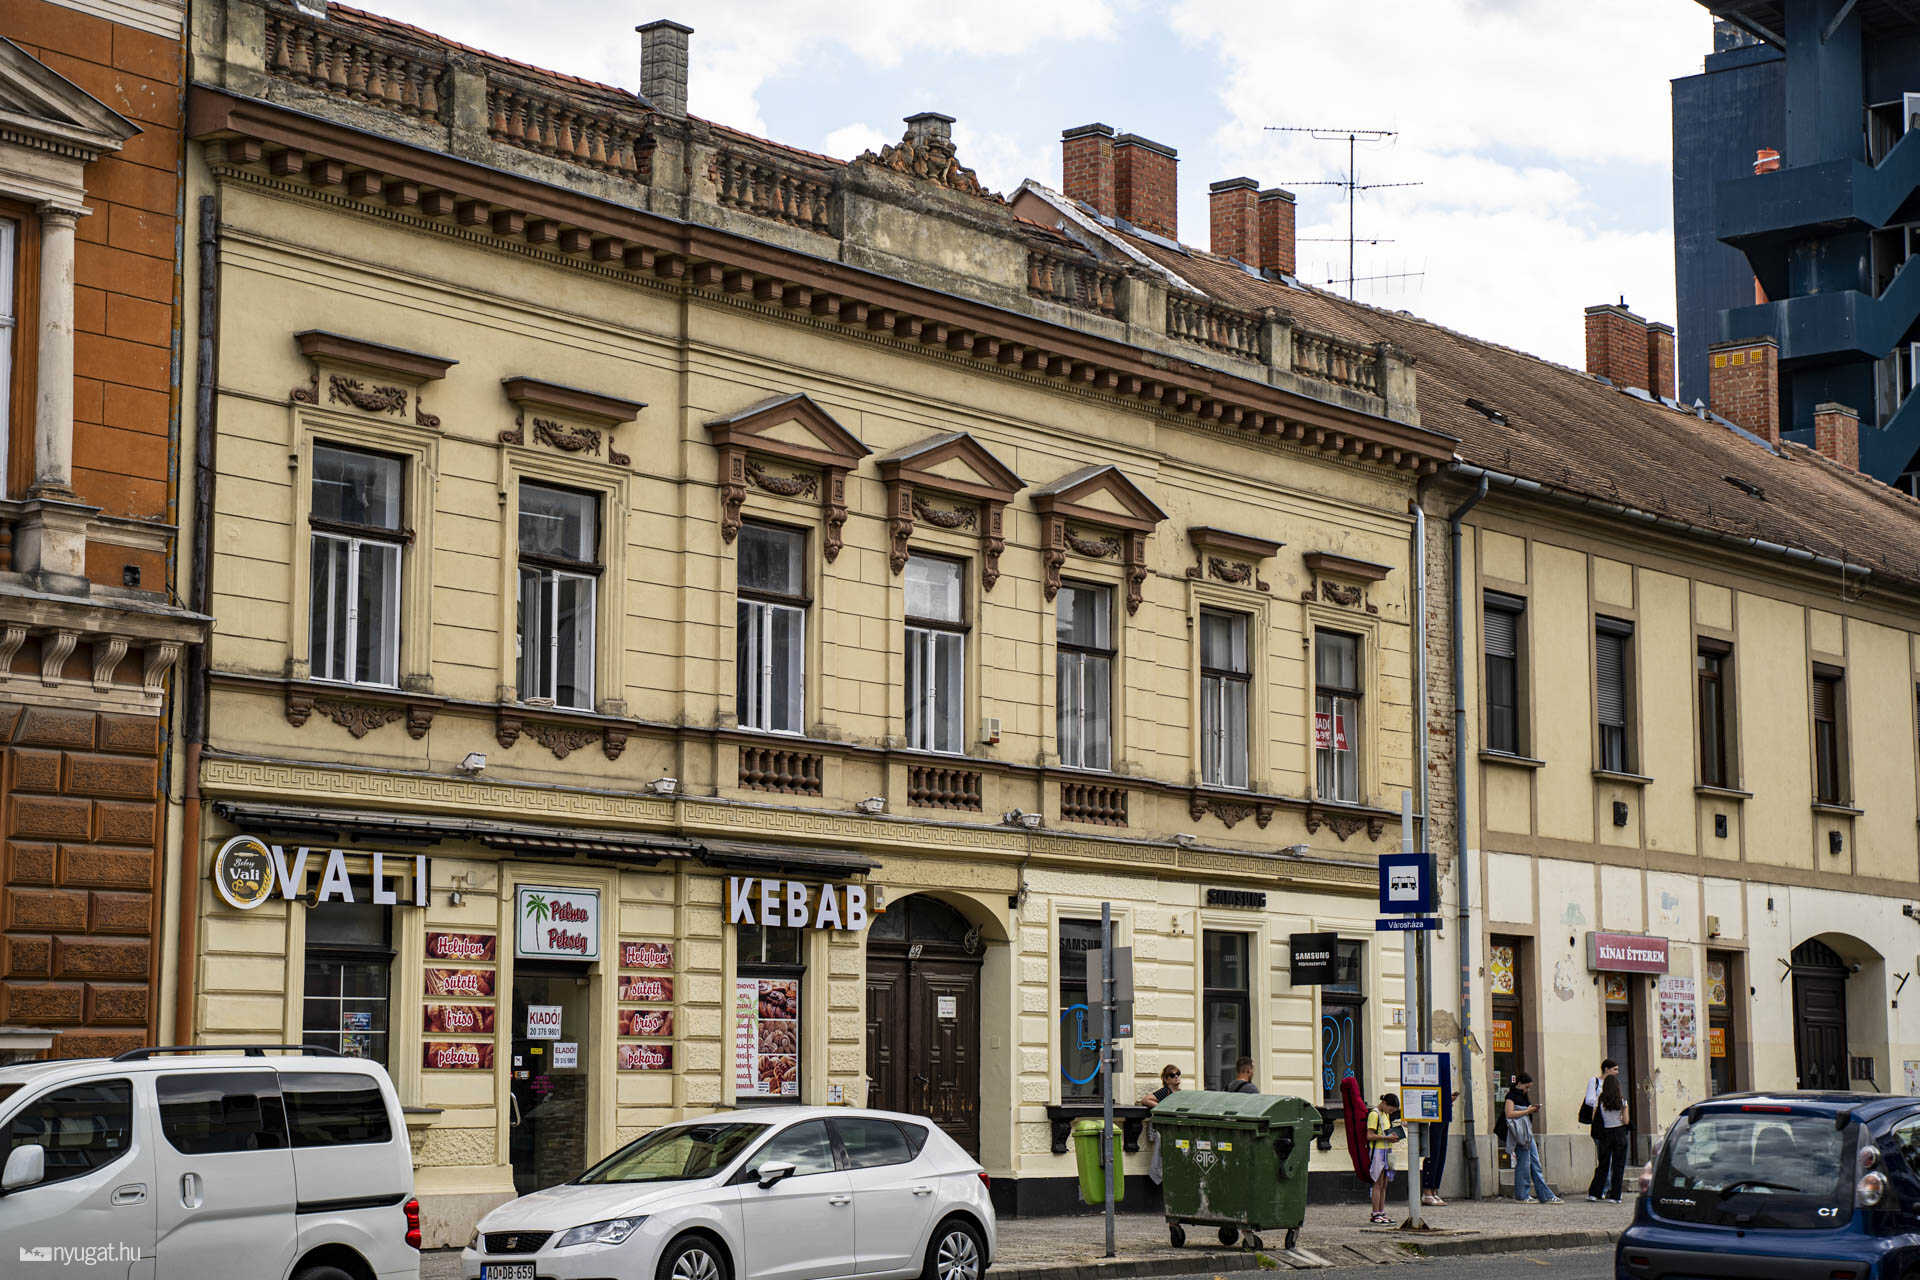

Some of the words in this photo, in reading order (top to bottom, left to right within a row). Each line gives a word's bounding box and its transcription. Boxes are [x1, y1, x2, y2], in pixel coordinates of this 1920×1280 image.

[230, 867, 260, 881] Vali
[271, 845, 426, 906] VALI
[730, 876, 867, 931] KEBAB
[1207, 889, 1266, 908] SAMSUNG
[549, 900, 589, 923] Pálma
[1387, 921, 1424, 930] Városháza
[437, 936, 485, 957] Helyben
[547, 928, 588, 954] Pékség
[626, 946, 668, 966] Helyben
[1295, 951, 1330, 960] SAMSUNG
[1600, 945, 1625, 960] KÍNAI
[1627, 946, 1665, 962] ÉTTEREM
[443, 975, 478, 991] sütött
[632, 981, 661, 997] sütött
[445, 1008, 473, 1028] friss
[529, 1009, 560, 1025] KIADÓ!
[634, 1013, 658, 1032] friss
[438, 1047, 480, 1067] pékáru
[627, 1049, 664, 1069] pékáru
[1817, 1207, 1839, 1217] C1
